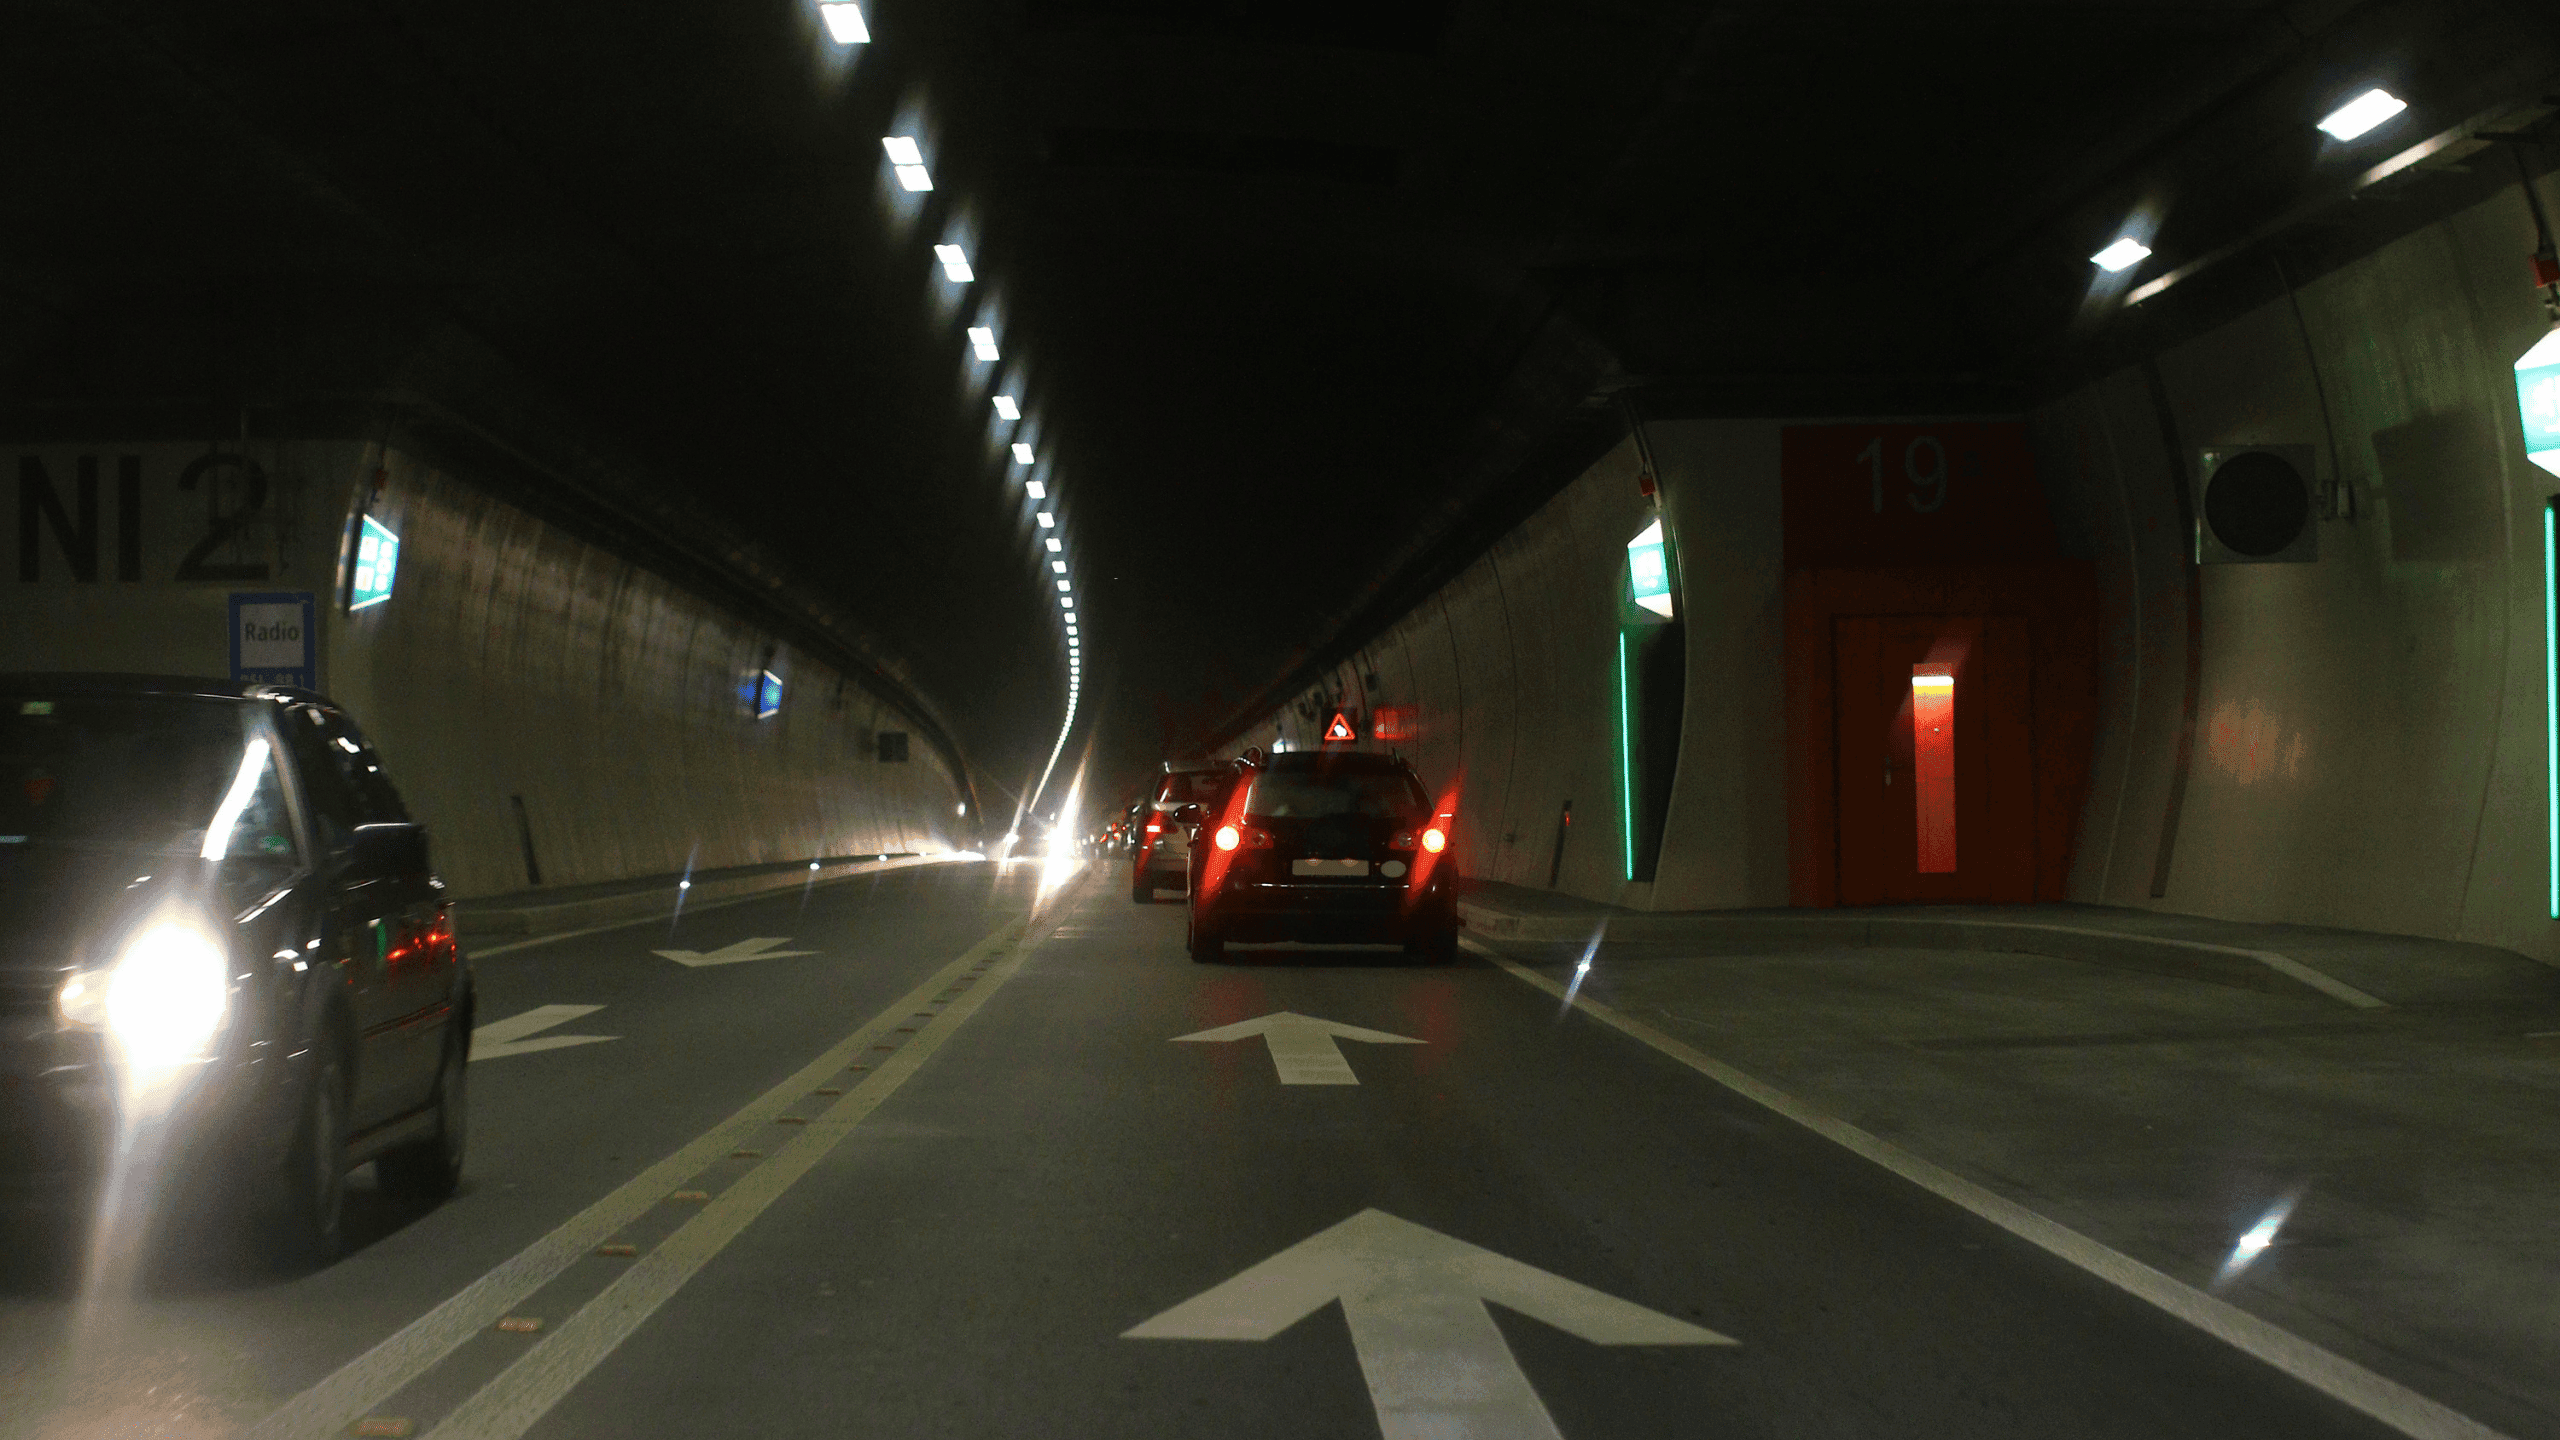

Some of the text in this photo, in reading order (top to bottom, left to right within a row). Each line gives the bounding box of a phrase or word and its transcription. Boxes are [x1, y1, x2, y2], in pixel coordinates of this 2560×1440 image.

[1855, 435, 1948, 514] 19
[18, 453, 271, 583] NI 2
[244, 622, 300, 641] Radio
